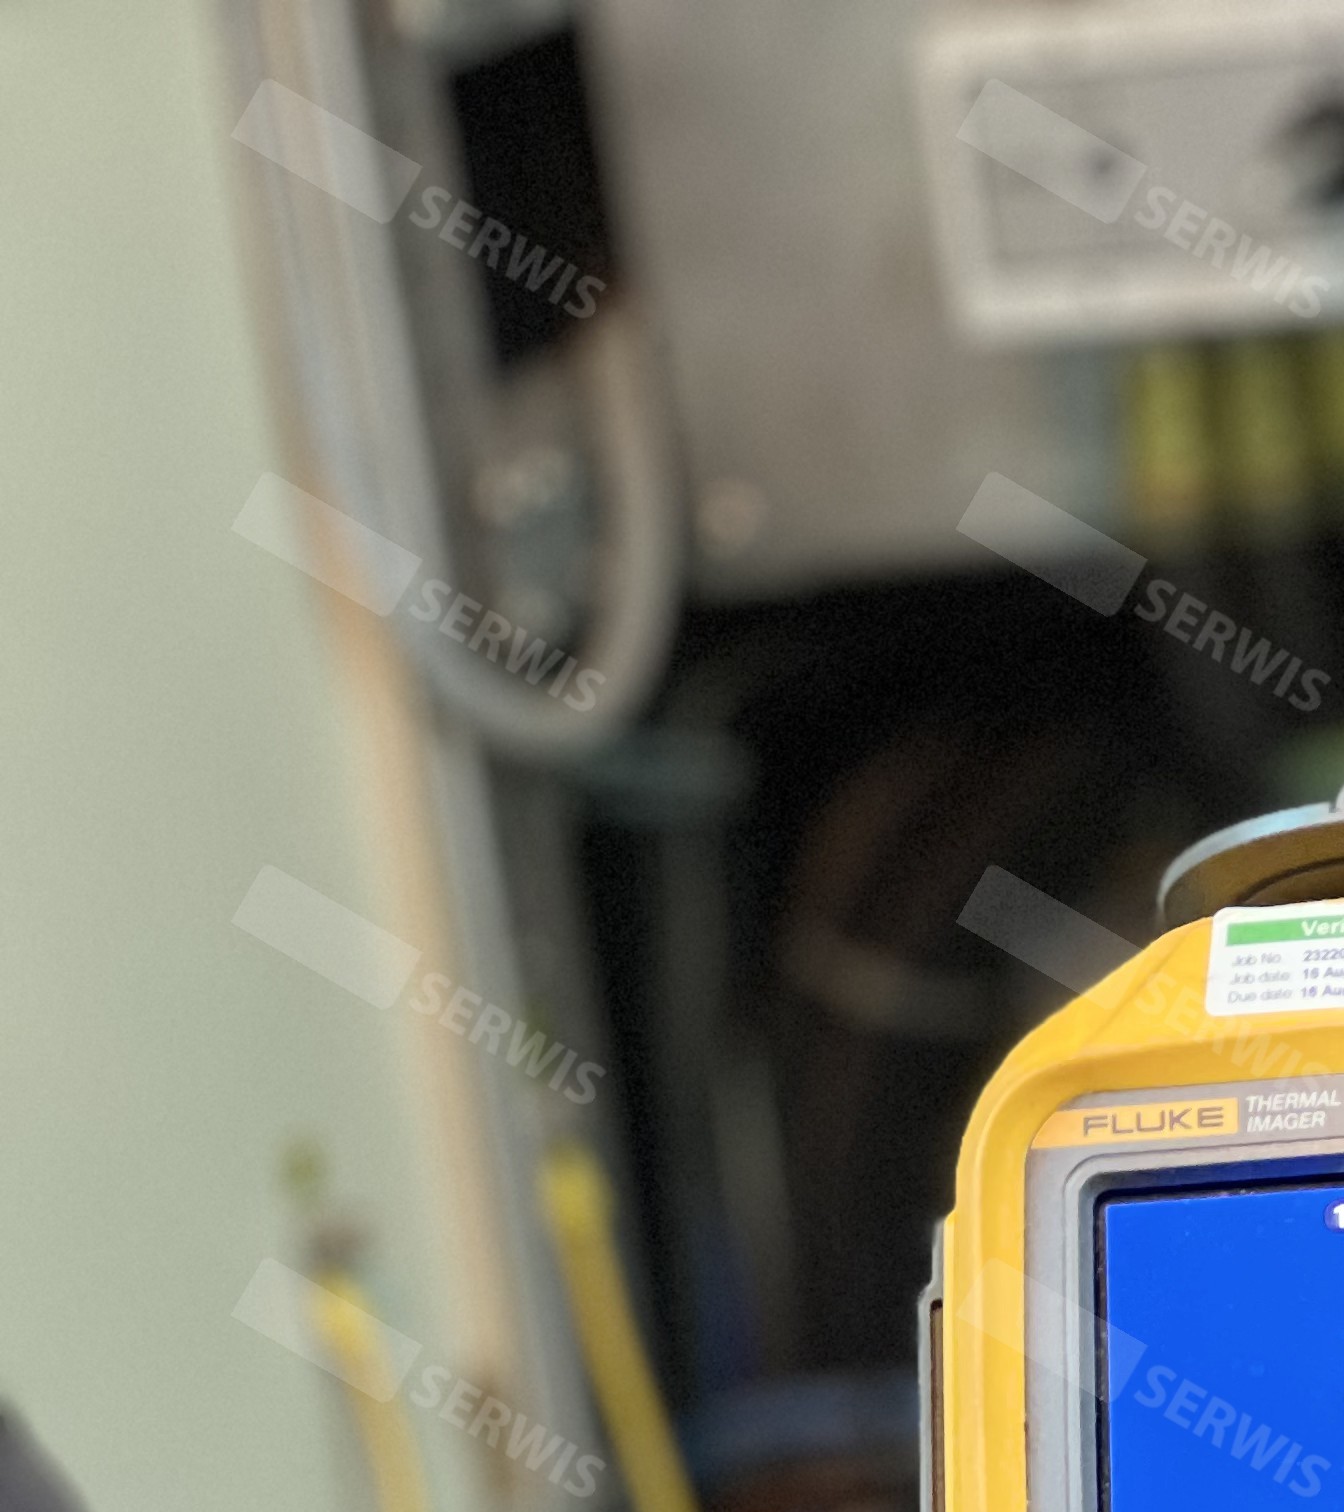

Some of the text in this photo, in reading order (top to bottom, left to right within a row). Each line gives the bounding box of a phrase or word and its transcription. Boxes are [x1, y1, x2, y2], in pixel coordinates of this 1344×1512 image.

[1231, 954, 1255, 967] Job
[1229, 973, 1256, 985] Job
[1257, 970, 1290, 984] date
[1227, 990, 1257, 1003] Due
[1260, 988, 1293, 1001] date
[1245, 1089, 1342, 1114] THERMAL
[1082, 1106, 1225, 1137] FLUKE
[1246, 1110, 1326, 1133] IMAGER
